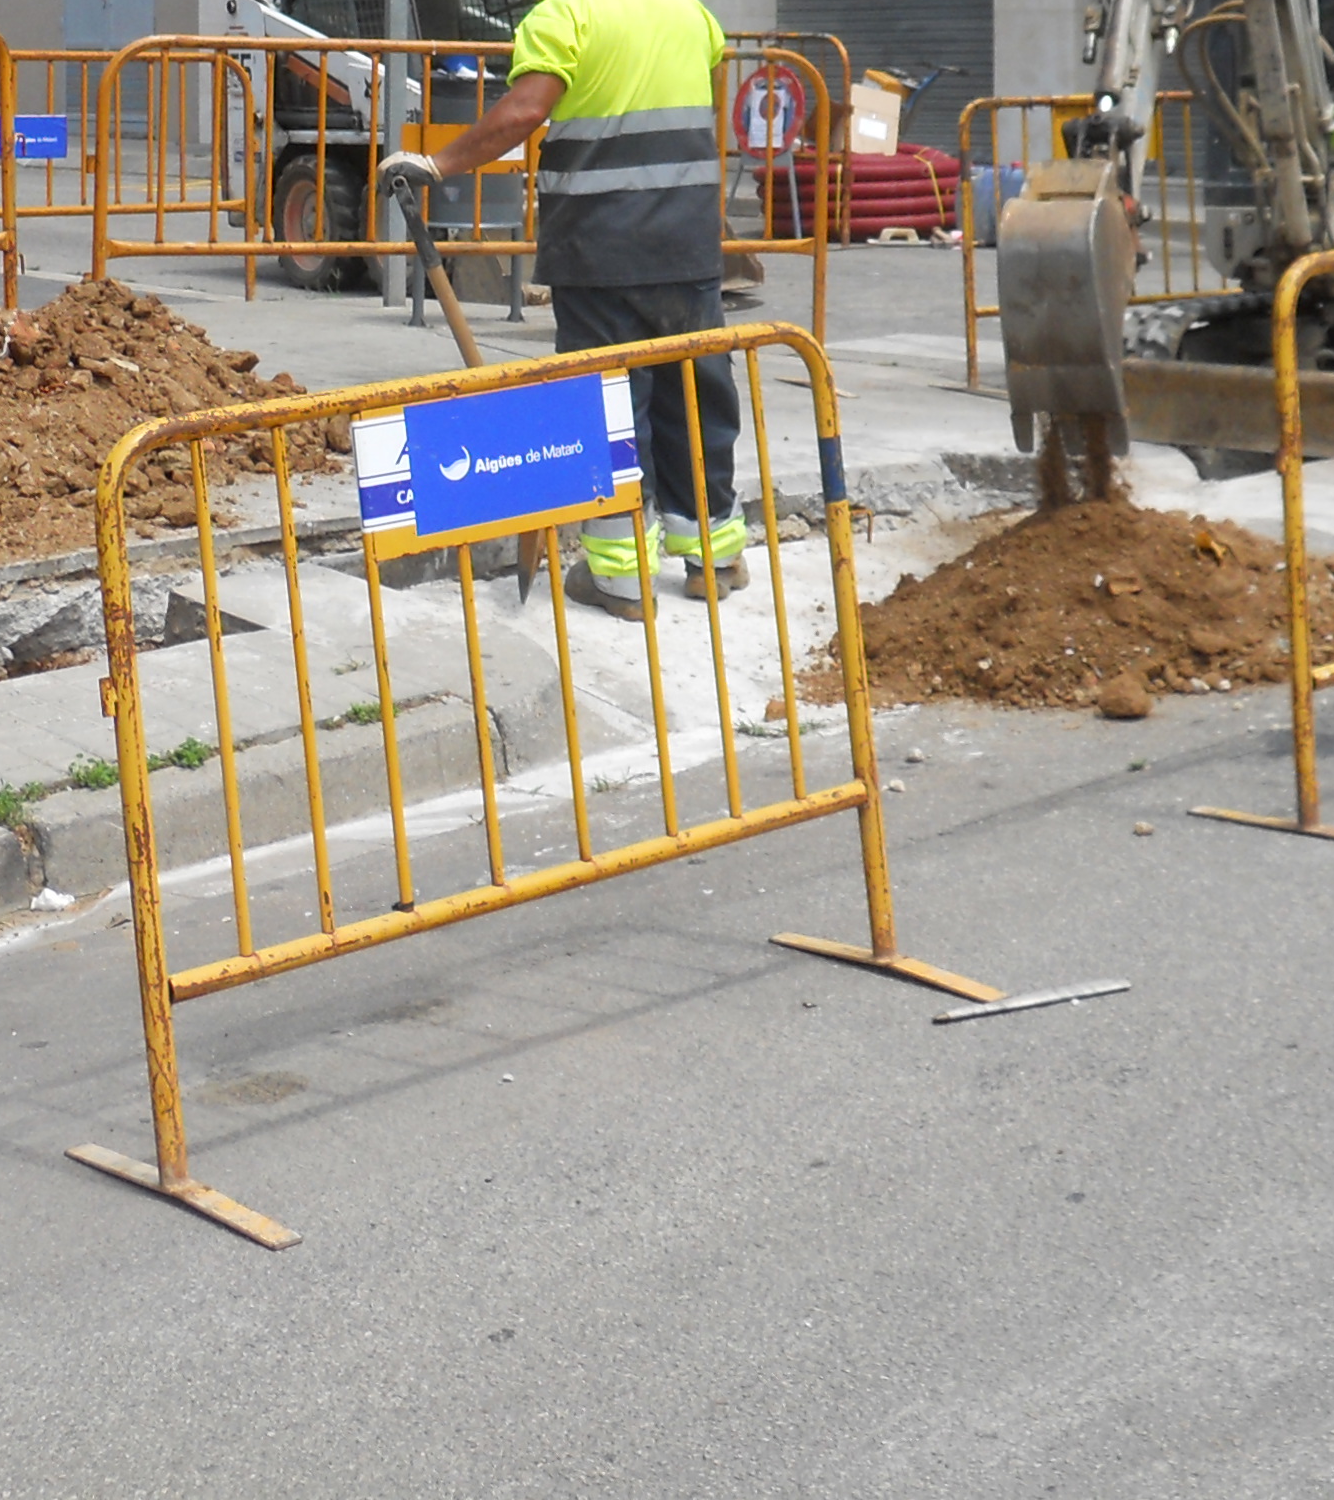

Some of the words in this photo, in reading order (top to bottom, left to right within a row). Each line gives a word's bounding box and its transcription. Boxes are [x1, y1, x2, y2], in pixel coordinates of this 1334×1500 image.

[474, 452, 523, 475] Aigües
[525, 448, 541, 464] de
[542, 438, 584, 461] Mataró
